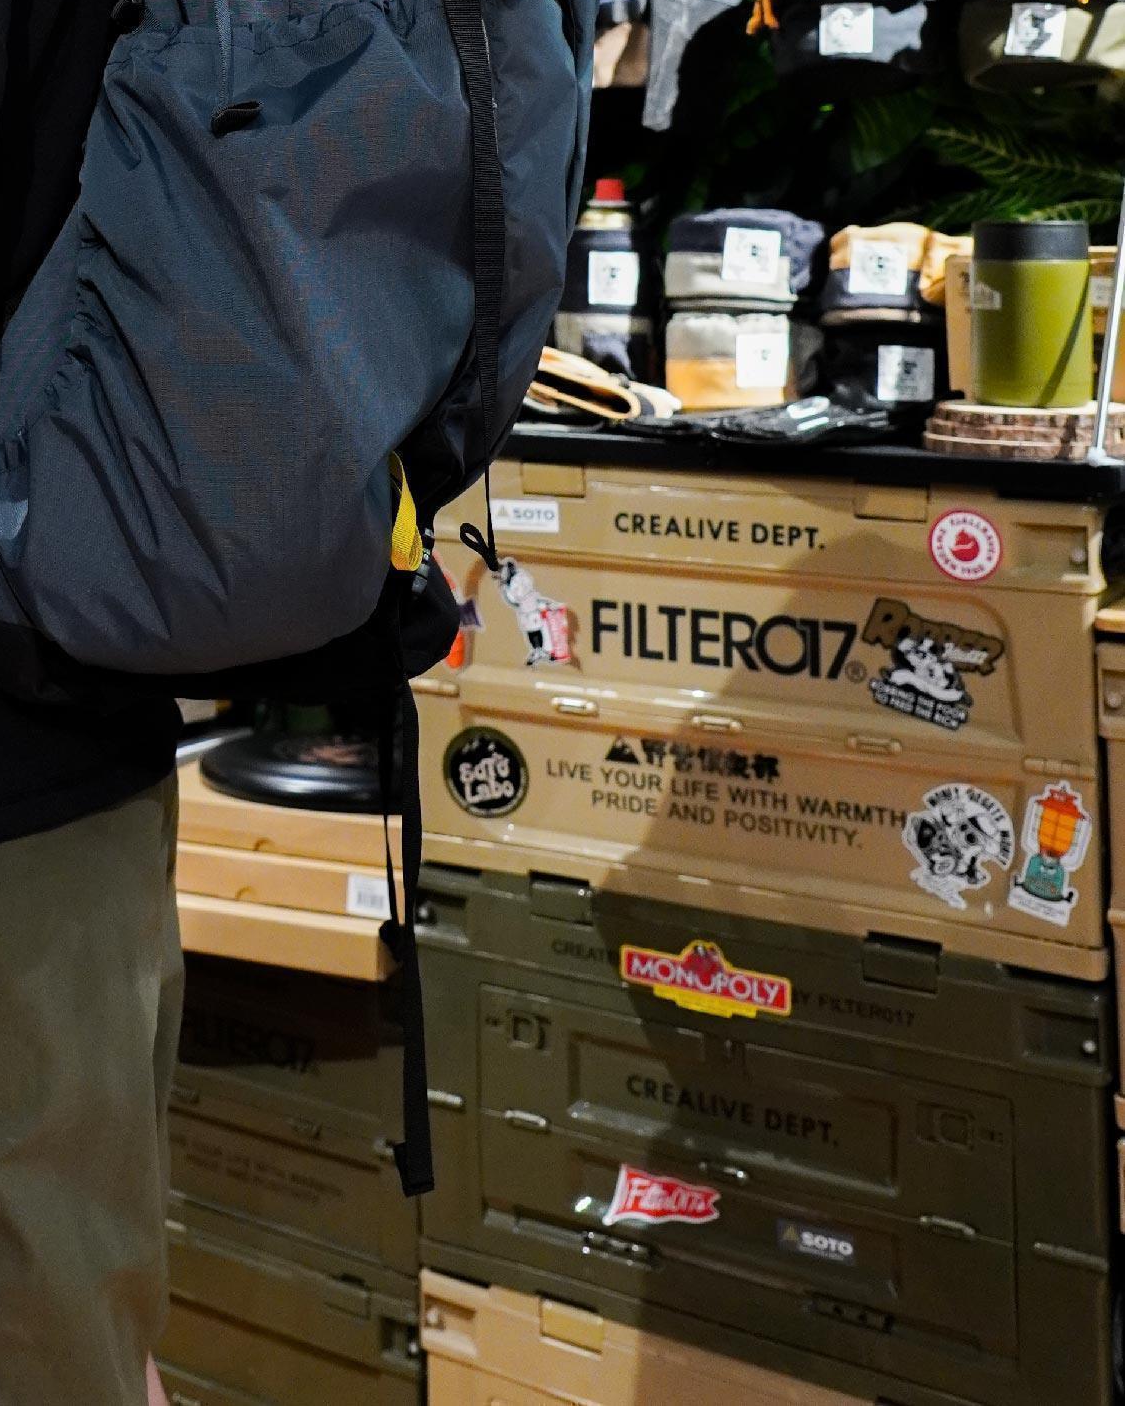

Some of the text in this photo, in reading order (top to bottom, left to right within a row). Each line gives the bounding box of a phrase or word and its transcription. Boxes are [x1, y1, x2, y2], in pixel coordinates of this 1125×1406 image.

[512, 506, 556, 523] SOTO
[614, 512, 826, 550] CREALIVE DEPT.
[546, 758, 907, 829] LIVE YOUR LIFE WITH WARMTH
[592, 790, 864, 849] PRIDE AND POSITIVITY.
[630, 956, 780, 1005] MONOPOLY
[764, 1107, 840, 1148] DEPT.
[800, 1230, 854, 1257] SOTO
